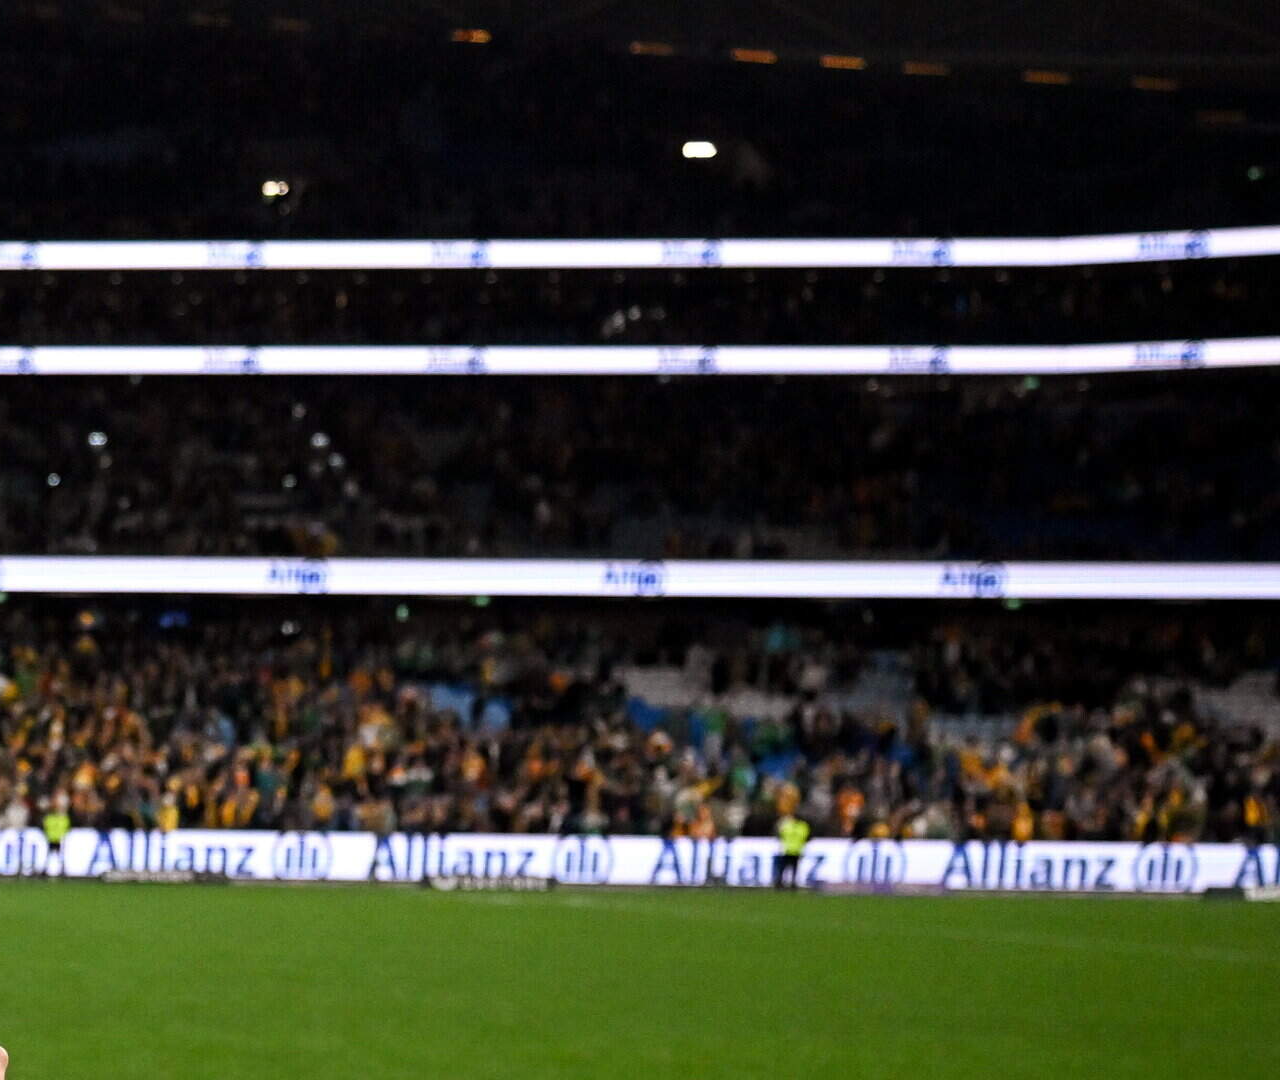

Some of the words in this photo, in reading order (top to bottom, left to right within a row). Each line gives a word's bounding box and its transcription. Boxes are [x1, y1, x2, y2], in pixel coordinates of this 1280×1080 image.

[90, 829, 255, 875] Allianz
[367, 834, 535, 880] Allianz
[650, 837, 827, 886] Alliaz
[944, 841, 1114, 888] Allianz
